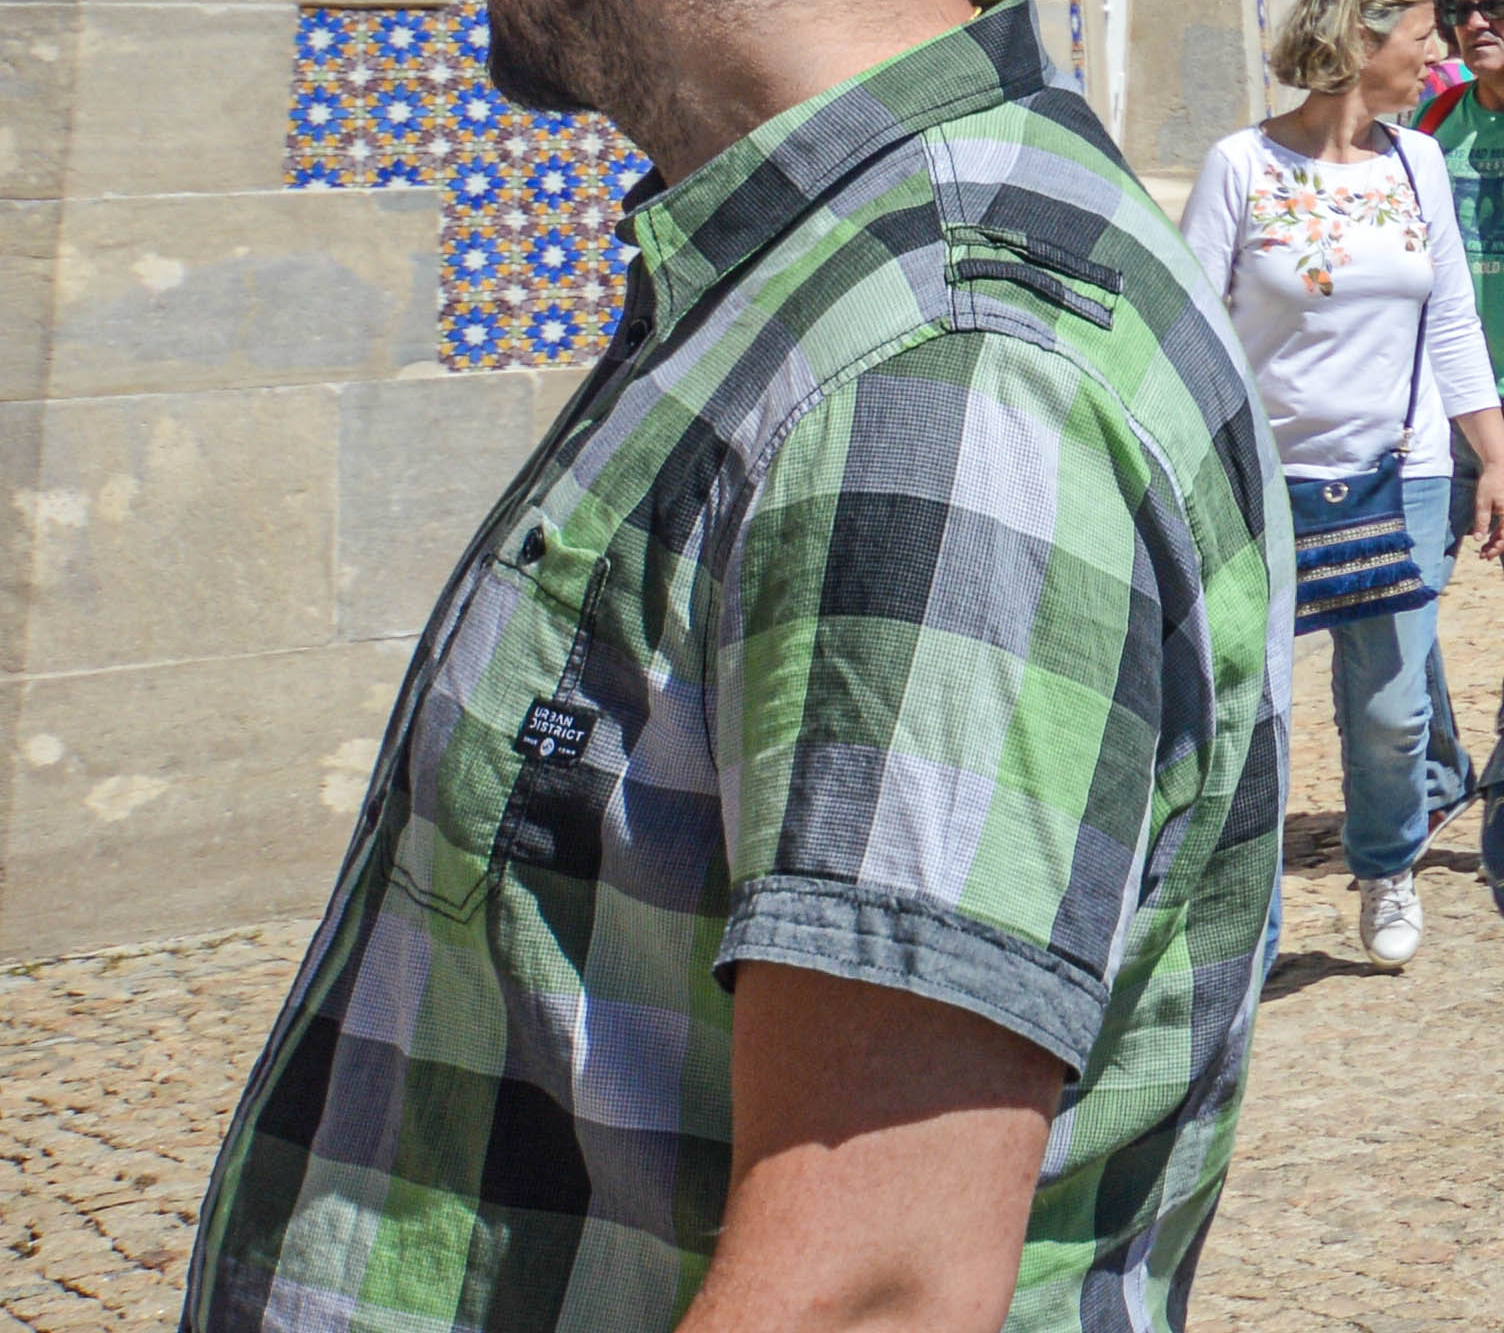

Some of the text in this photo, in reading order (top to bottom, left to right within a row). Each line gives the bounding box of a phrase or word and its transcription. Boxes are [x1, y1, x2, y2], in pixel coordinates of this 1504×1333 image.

[1472, 260, 1500, 273] SOLD
[534, 706, 573, 727] URBAN
[529, 718, 585, 741] DISTRICT
